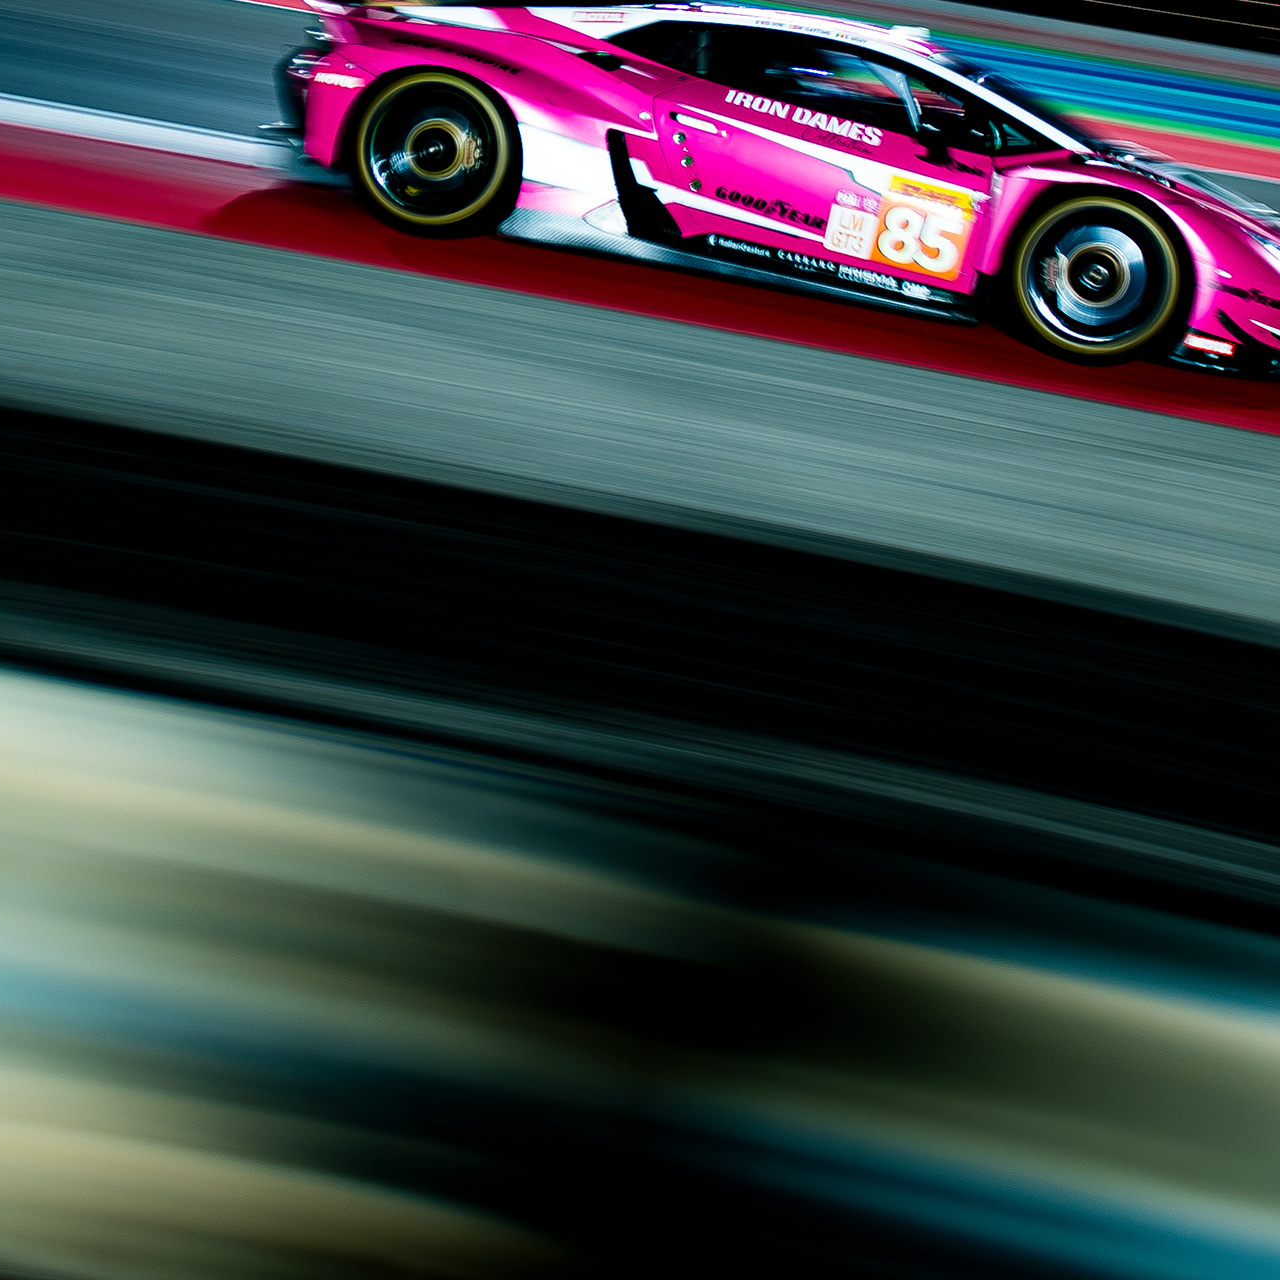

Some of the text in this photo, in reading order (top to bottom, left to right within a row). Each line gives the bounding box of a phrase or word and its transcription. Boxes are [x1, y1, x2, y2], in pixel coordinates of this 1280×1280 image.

[724, 89, 884, 147] IRON DAMES
[839, 210, 864, 232] LM
[877, 206, 964, 273] 85
[831, 230, 863, 253] GT3
